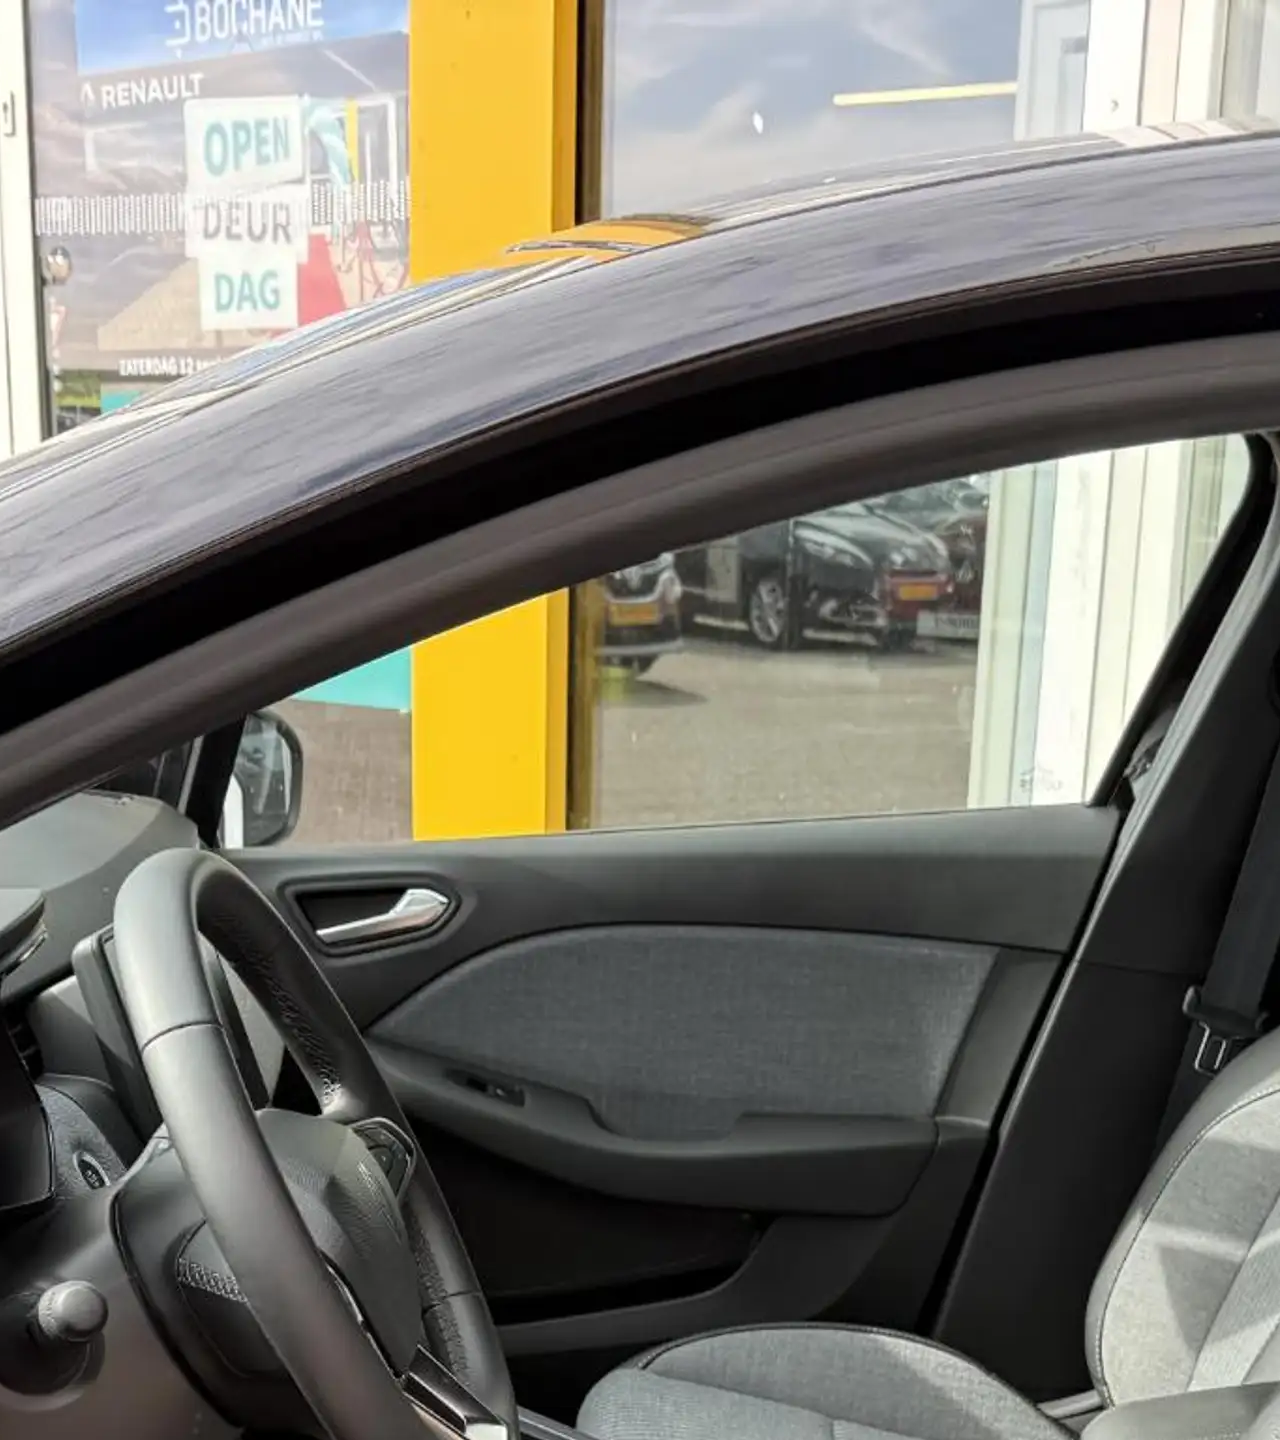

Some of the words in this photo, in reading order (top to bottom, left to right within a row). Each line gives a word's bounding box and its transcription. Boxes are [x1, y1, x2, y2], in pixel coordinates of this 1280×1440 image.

[195, 0, 324, 42] BOCHANE
[101, 74, 203, 110] RENAULT
[204, 116, 290, 177] OPEN
[203, 199, 292, 244] DEUR
[214, 269, 280, 312] DAG
